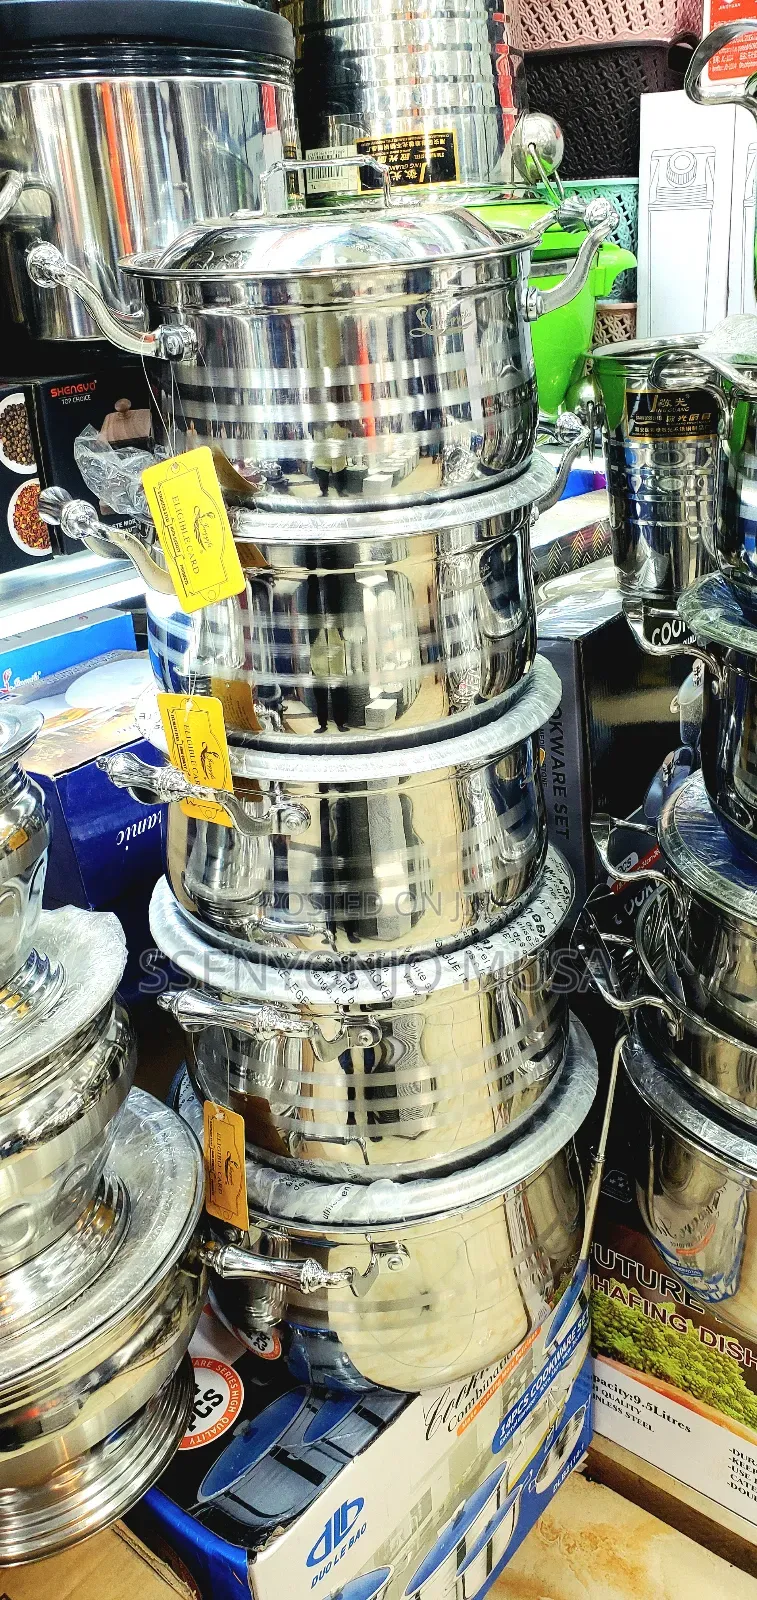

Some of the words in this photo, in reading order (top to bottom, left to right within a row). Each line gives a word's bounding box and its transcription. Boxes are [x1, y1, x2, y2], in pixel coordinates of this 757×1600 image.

[172, 495, 190, 544] ELIGIBLE
[187, 544, 200, 575] CARD
[554, 802, 570, 841] SET
[590, 1241, 706, 1315] UTURE
[215, 1364, 238, 1389] SERIES
[227, 1390, 239, 1413] HIGH
[601, 1388, 642, 1415] QUALITY
[188, 1416, 230, 1446] QUALITY
[624, 1410, 655, 1433] STEEL
[311, 1561, 333, 1590] DUO
[333, 1544, 348, 1566] LE
[348, 1521, 367, 1551] BAO
